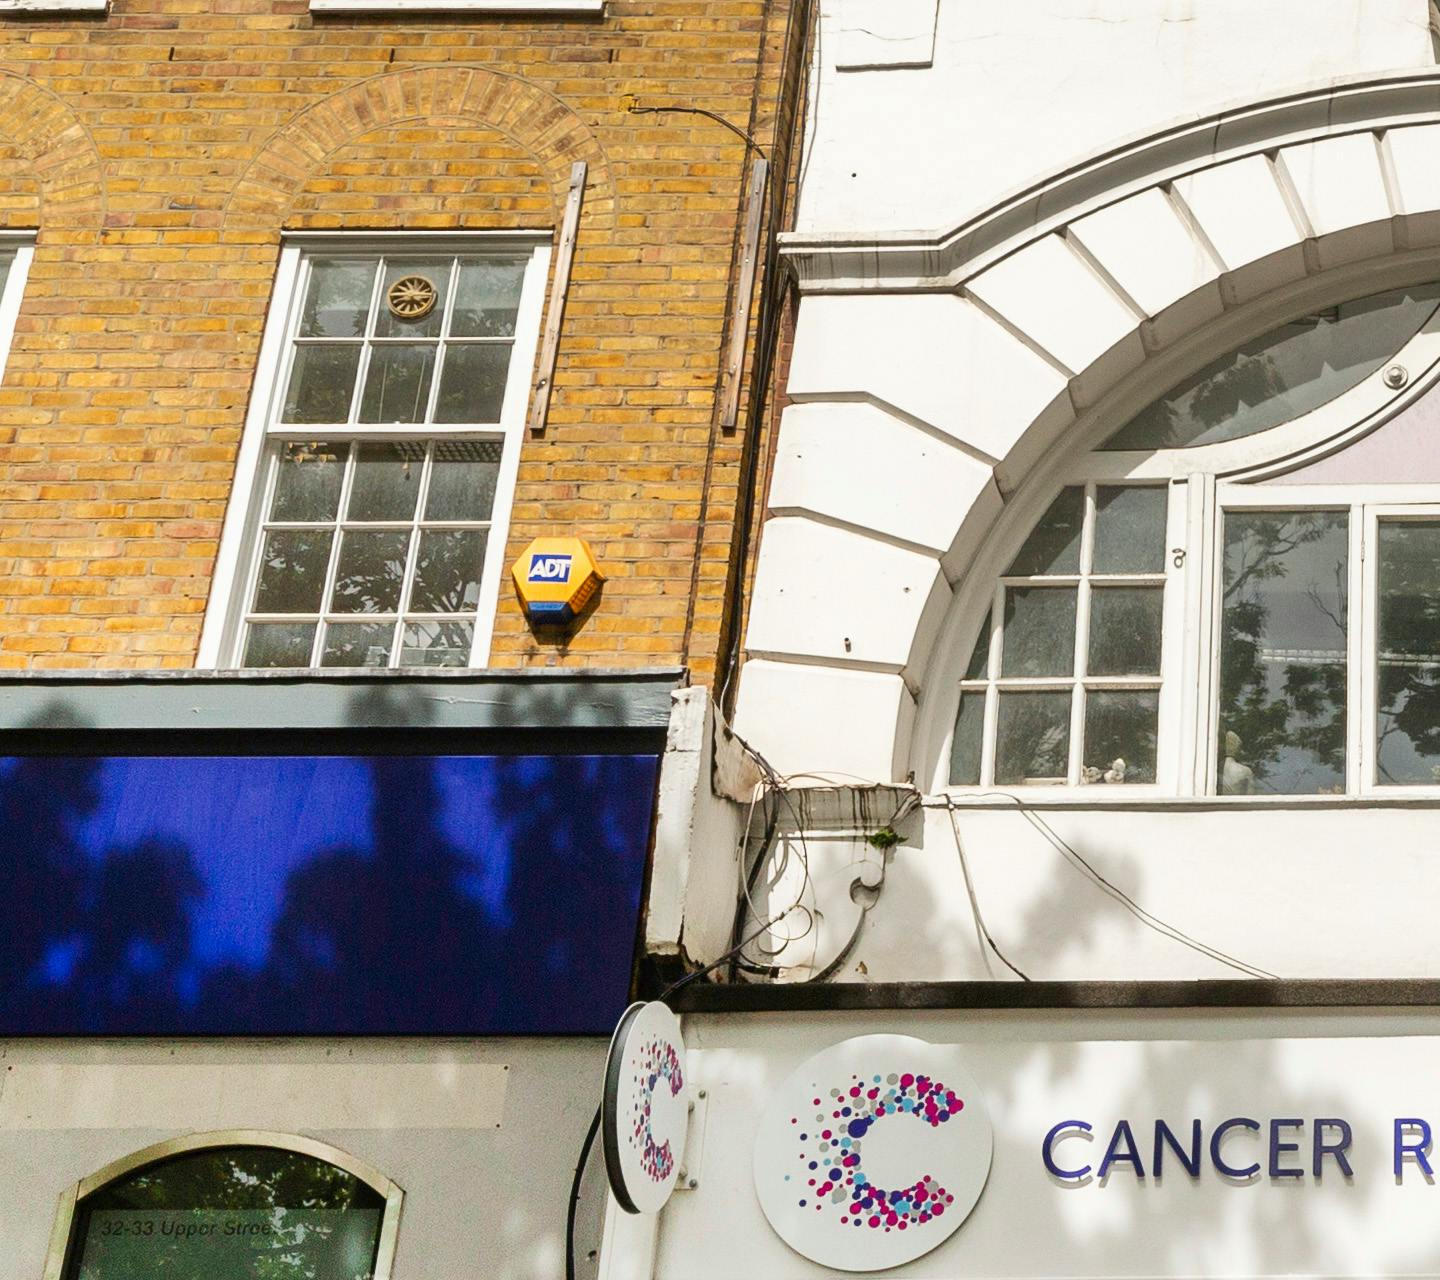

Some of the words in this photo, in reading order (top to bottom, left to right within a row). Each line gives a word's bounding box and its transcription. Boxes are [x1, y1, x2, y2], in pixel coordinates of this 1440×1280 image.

[528, 558, 571, 579] ADT
[1040, 1117, 1354, 1180] CANCER
[101, 1220, 154, 1236] 32-33
[161, 1220, 217, 1239] Upper
[223, 1220, 277, 1236] Stree
